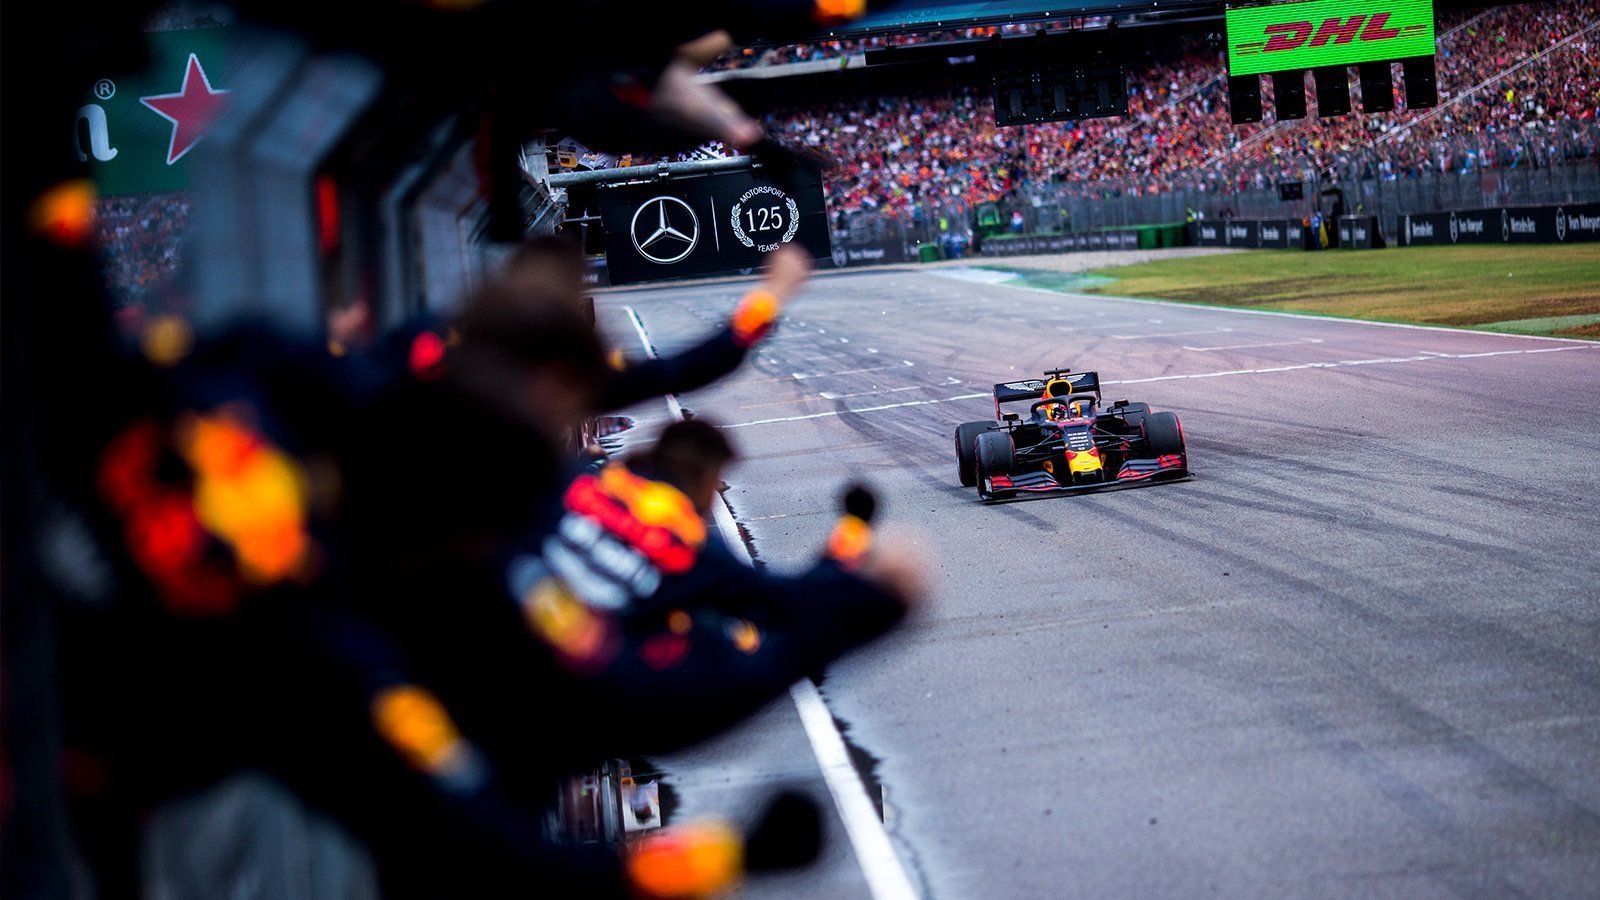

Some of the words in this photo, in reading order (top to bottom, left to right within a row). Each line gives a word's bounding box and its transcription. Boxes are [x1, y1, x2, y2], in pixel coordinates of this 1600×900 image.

[1262, 12, 1400, 53] DHL
[740, 186, 786, 203] MOTORSPORT
[746, 206, 783, 232] 125
[757, 242, 780, 252] YEARS
